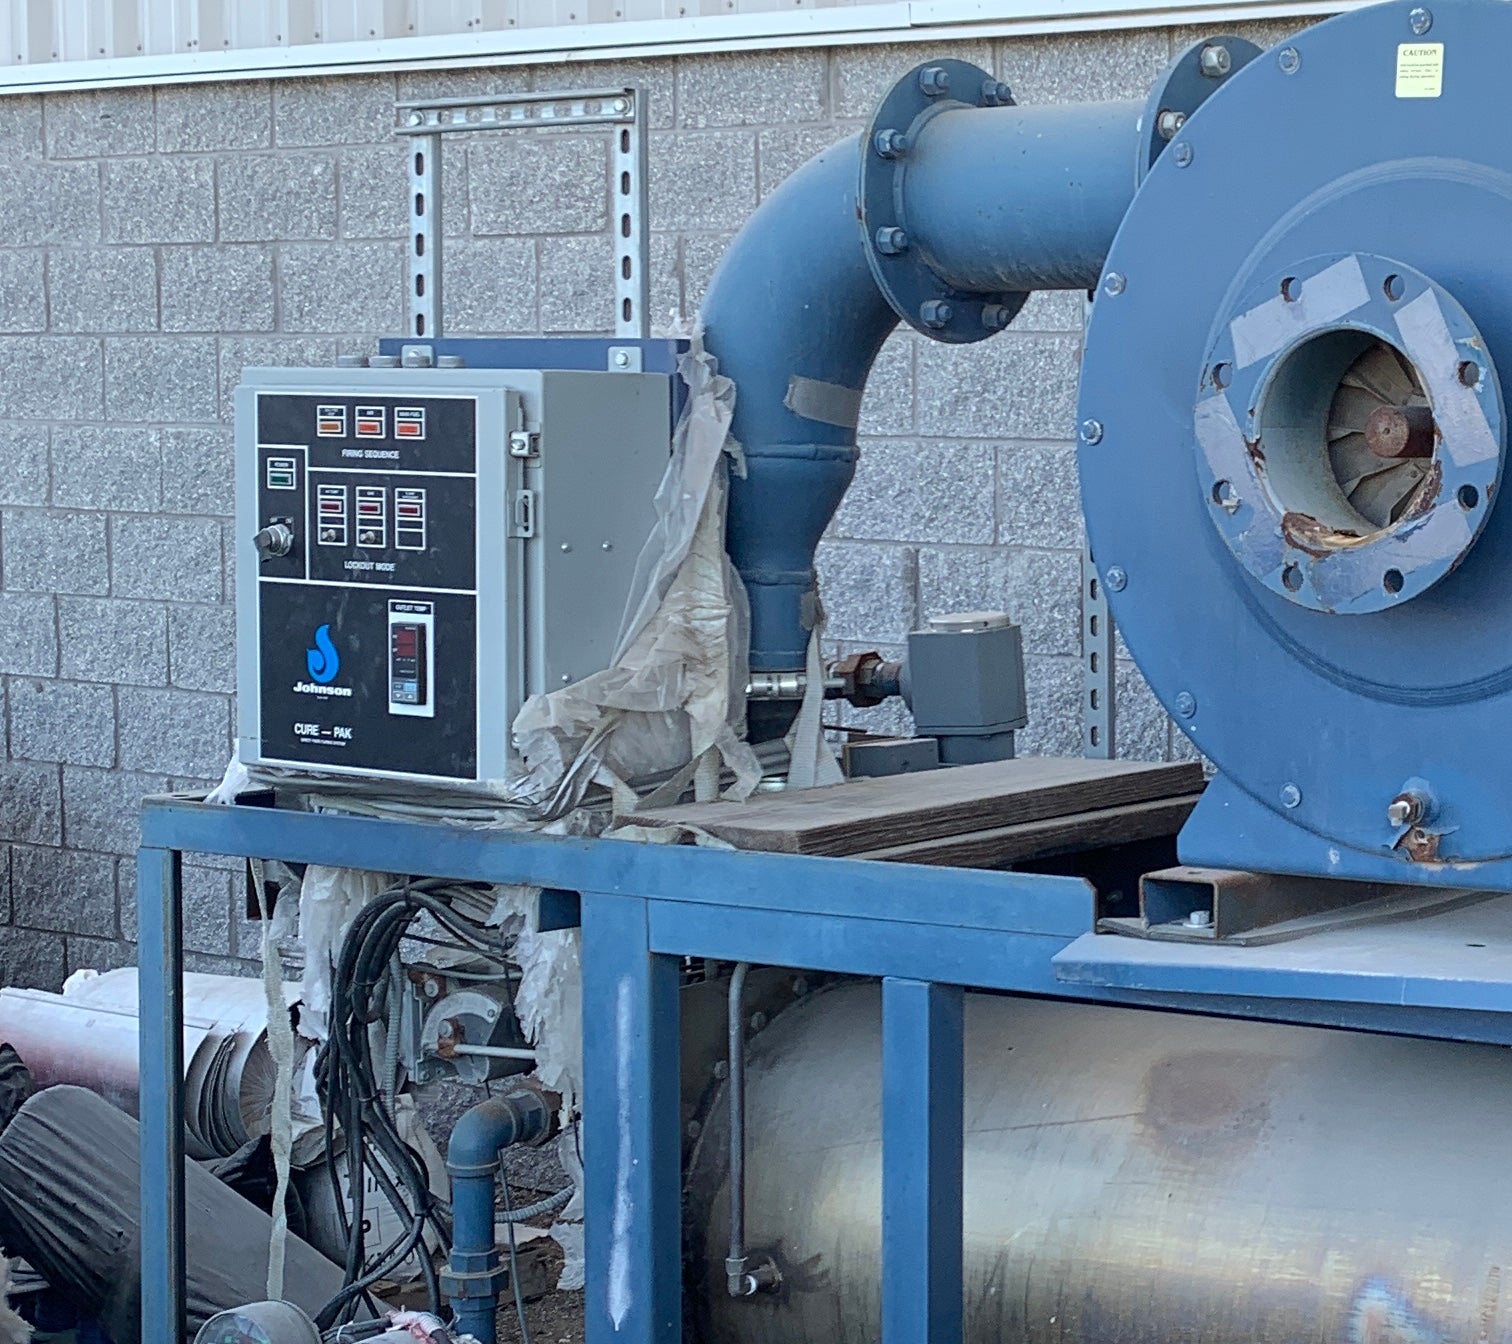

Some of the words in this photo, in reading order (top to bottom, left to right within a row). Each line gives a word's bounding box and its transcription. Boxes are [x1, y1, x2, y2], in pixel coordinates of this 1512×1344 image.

[364, 449, 400, 459] SEQUENCE
[344, 560, 375, 571] LOCKOUT
[375, 562, 396, 572] MODE
[293, 681, 352, 696] Johnson
[294, 723, 320, 736] CURE
[333, 726, 353, 739] PAK
